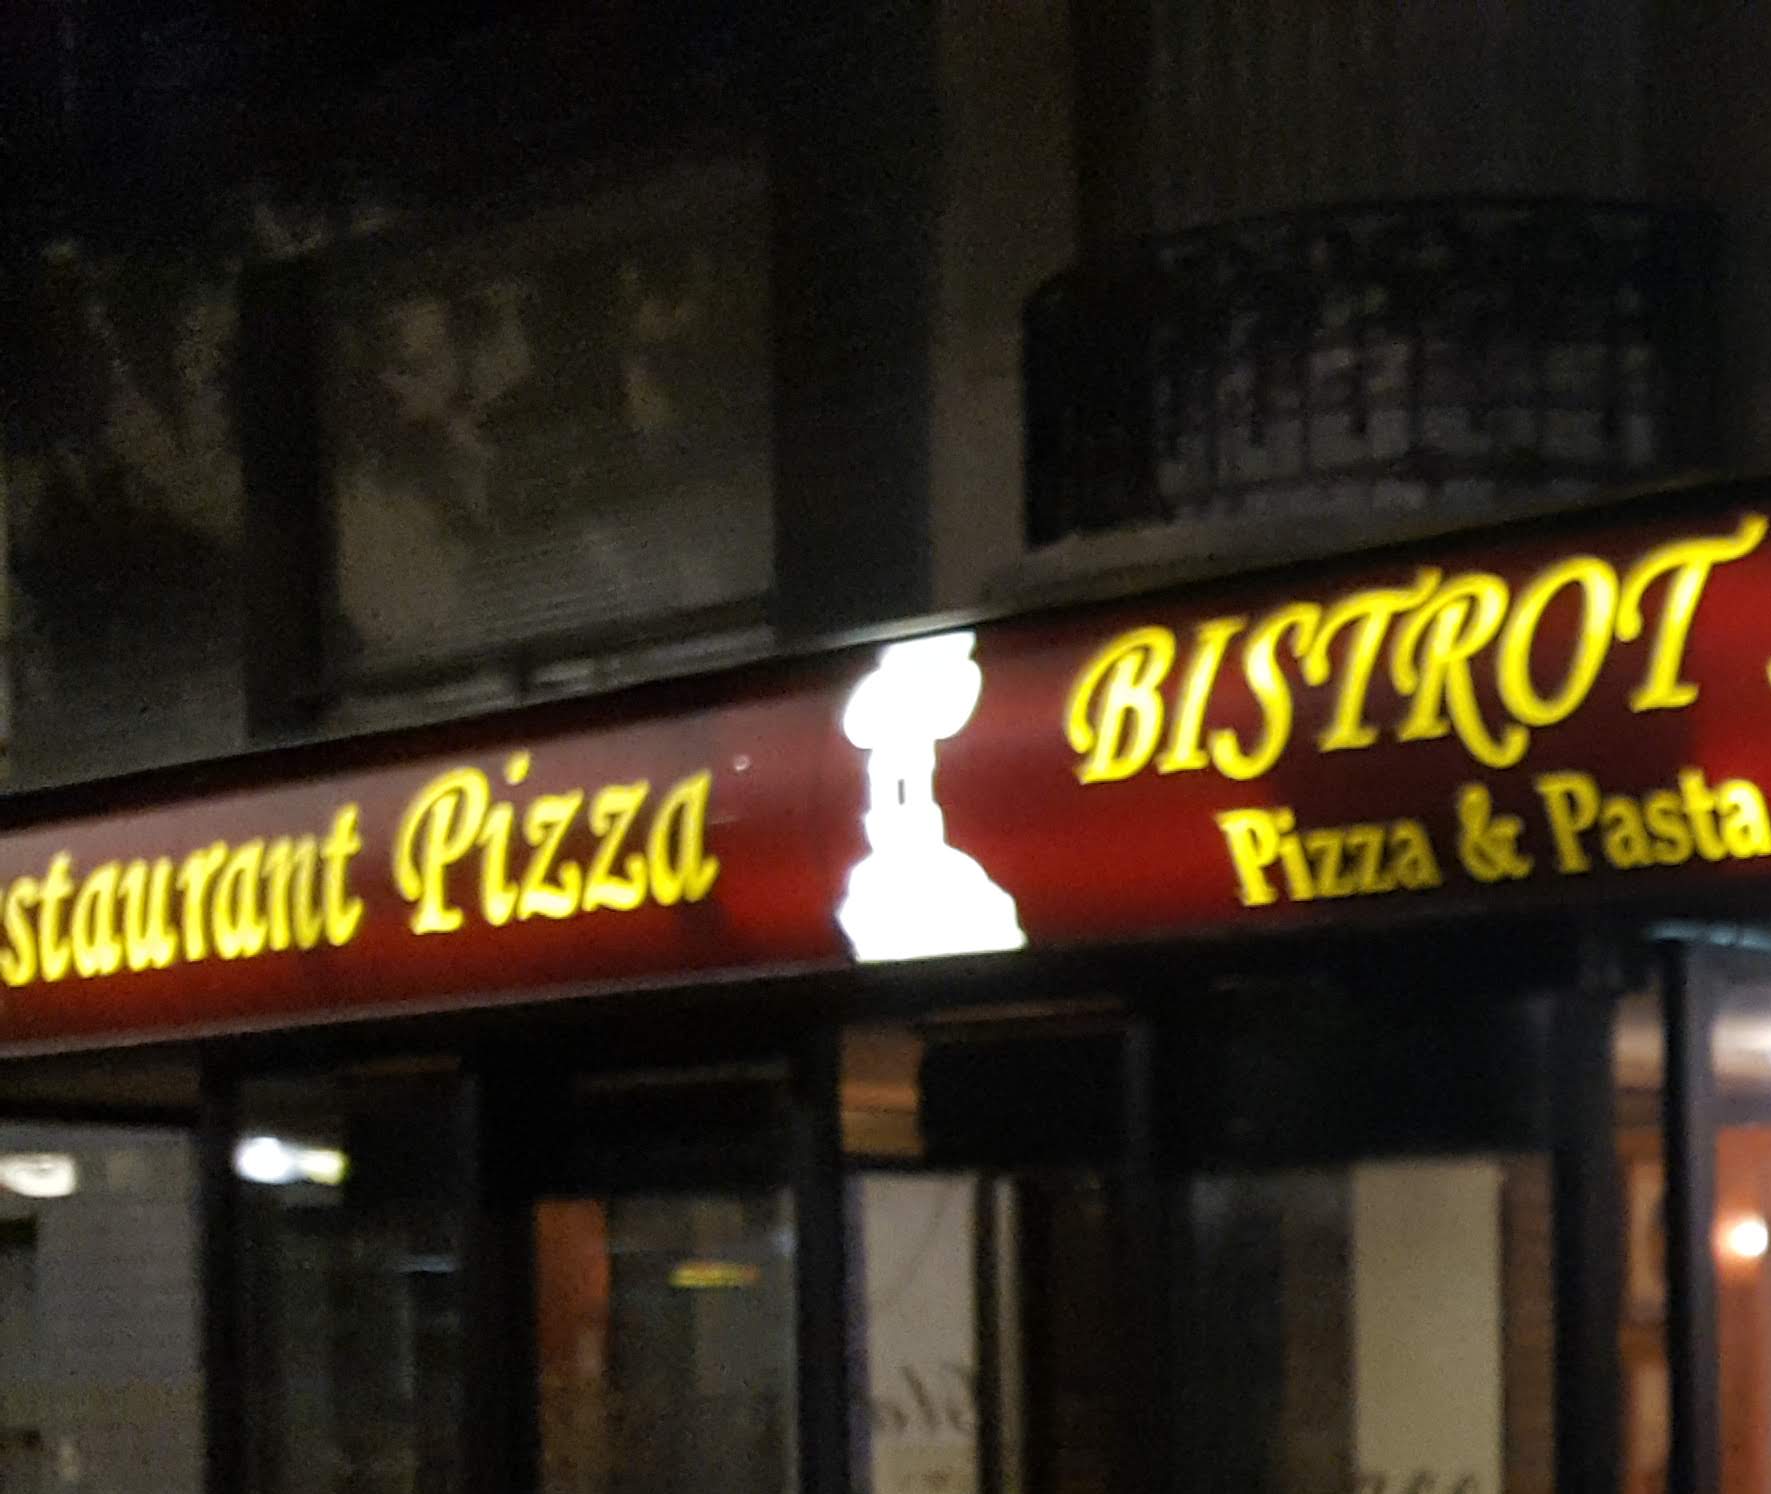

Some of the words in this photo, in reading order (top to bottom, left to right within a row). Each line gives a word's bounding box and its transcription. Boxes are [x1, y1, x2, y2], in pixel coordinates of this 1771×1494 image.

[1064, 514, 1769, 785] BISTROT
[0, 802, 366, 988] staurant
[393, 750, 721, 935] Pizza
[1215, 806, 1443, 908] Pizza
[1456, 782, 1533, 883] &
